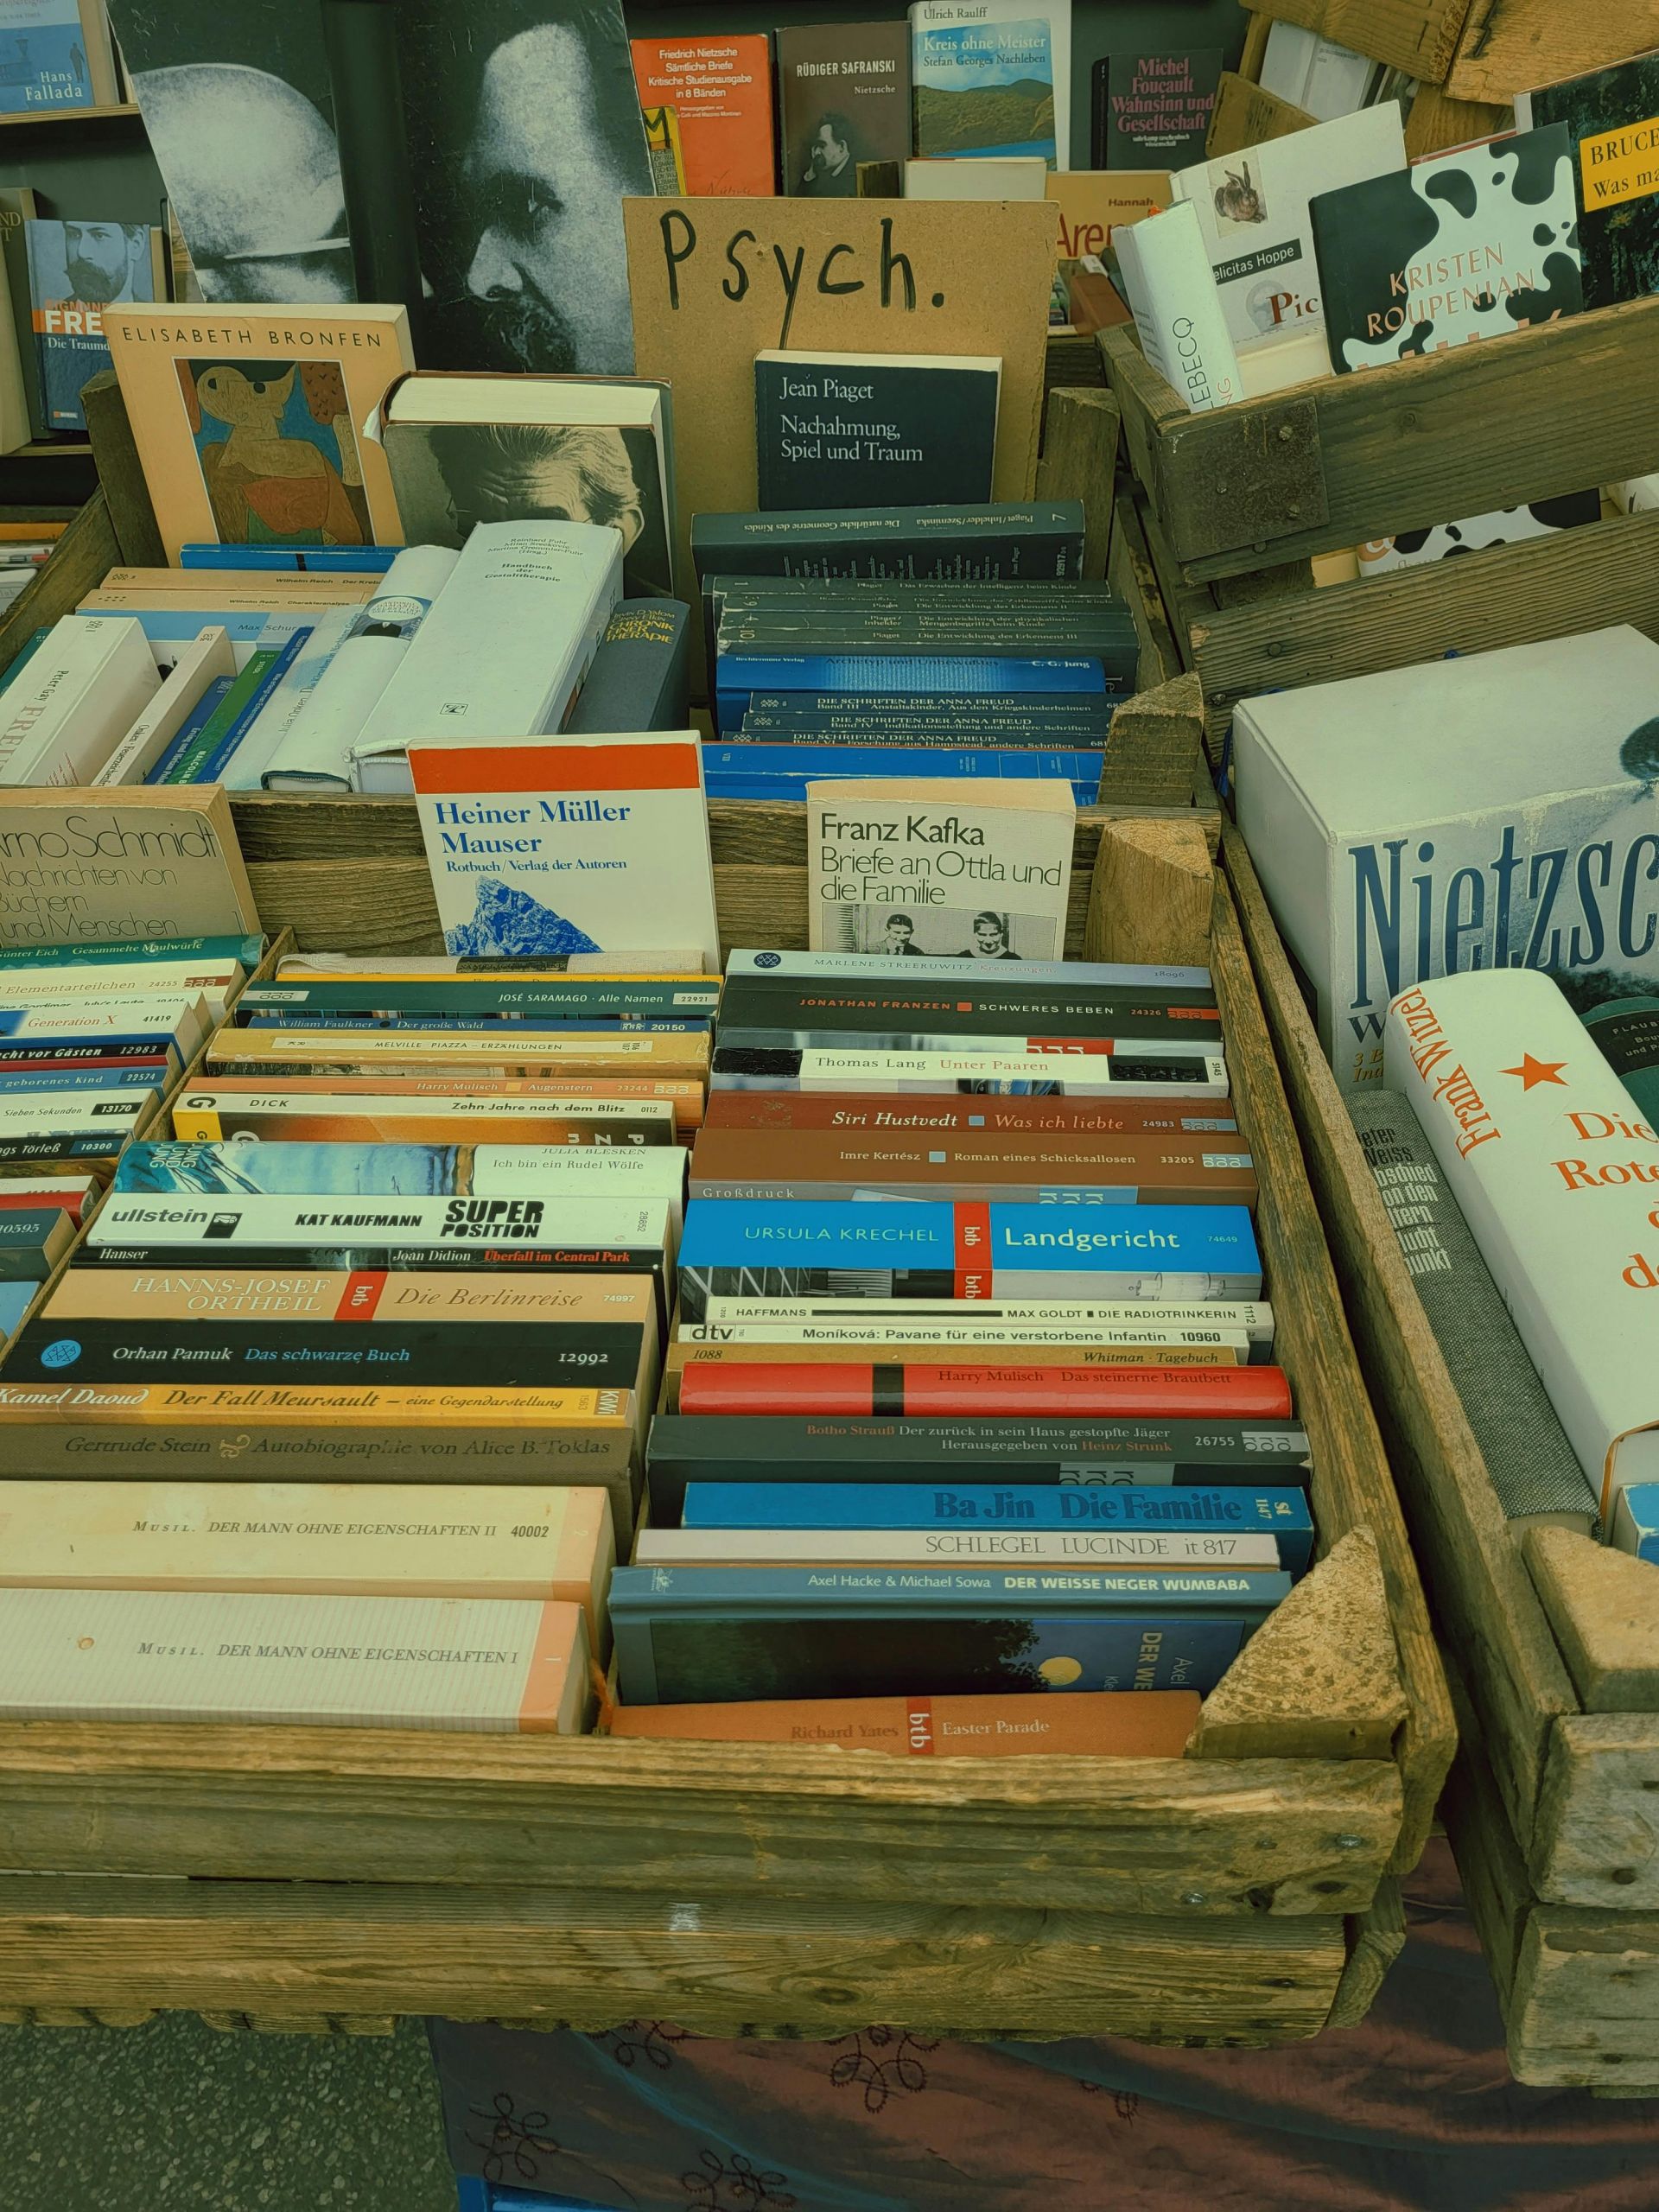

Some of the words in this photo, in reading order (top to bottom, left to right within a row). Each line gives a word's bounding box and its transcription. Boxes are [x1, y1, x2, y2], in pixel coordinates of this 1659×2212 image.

[924, 7, 954, 20] Ulrich
[957, 6, 988, 19] Raulff
[924, 36, 957, 51] Kreis
[961, 37, 993, 51] ohne
[998, 35, 1046, 49] Meister
[659, 49, 695, 59] Friedrich
[697, 48, 737, 58] Nietzsche
[923, 55, 952, 67] Stefan
[956, 55, 993, 68] Georges
[995, 53, 1046, 65] Nachleben
[665, 61, 704, 73] Sämtliche
[706, 60, 733, 71] Briefe
[797, 63, 838, 77] RÜDIGER
[842, 60, 895, 74] SAFRANSKI
[1137, 57, 1190, 77] Michel
[41, 71, 72, 82] Hans
[648, 75, 683, 86] Kritische
[685, 73, 752, 86] Studienausgabe
[1131, 75, 1193, 94] Foucault
[25, 85, 82, 101] Fallada
[693, 86, 726, 98] Bänden
[854, 84, 895, 94] Nietzsche
[1112, 94, 1184, 114] Wahnsinn
[1186, 92, 1214, 111] und
[1117, 112, 1205, 133] Gesellschaft
[1592, 178, 1630, 199] Was
[1256, 246, 1295, 267] Hoppe
[1389, 243, 1505, 296] KRISTEN
[659, 209, 944, 351] Psych.
[1366, 268, 1536, 337] ROUPENIAN
[123, 327, 252, 345] ELISABETH
[269, 330, 382, 347] BRONFEN
[779, 377, 817, 399] Jean
[823, 380, 874, 401] Piaget
[780, 415, 900, 440] Nachahmung,
[780, 441, 821, 461] Spiel
[827, 443, 860, 461] und
[864, 443, 923, 461] Traum
[434, 803, 531, 828] Heiner
[540, 798, 631, 824] Müller
[67, 813, 216, 861] Schmidt
[821, 814, 899, 842] Franz
[906, 816, 985, 846] Kafka
[442, 831, 542, 855] Mauser
[551, 859, 572, 872] der
[575, 857, 627, 870] Autoren
[822, 848, 894, 874] Briefe
[899, 856, 931, 876] an
[936, 851, 1007, 882] Ottla
[1013, 861, 1061, 887] und
[135, 868, 177, 887] von
[821, 879, 859, 901] die
[862, 880, 946, 905] Familie
[0, 915, 47, 940] und
[48, 912, 178, 938] Menschen
[7, 979, 136, 995] Elementarteilchen
[498, 991, 524, 1003] JOSÉ
[527, 994, 588, 1003] SARAMAGO
[598, 994, 619, 1003] Alle
[623, 995, 664, 1004] Namen
[798, 998, 877, 1010] JONATHAN
[882, 1001, 950, 1012] FRANZEN
[979, 1003, 1059, 1014] SCHWERES
[1065, 1005, 1115, 1015] BEBEN
[28, 1016, 100, 1028] Generation
[104, 1014, 118, 1025] X
[1390, 988, 1453, 1084] Witzel
[29, 1049, 51, 1059] vor
[54, 1046, 102, 1058] Gästen
[120, 1045, 157, 1055] 12983
[815, 1058, 879, 1069] Thomas
[886, 1058, 926, 1071] Lang
[939, 1059, 986, 1070] Unter
[992, 1060, 1048, 1071] Paaren
[101, 1103, 132, 1114] 13170
[249, 1098, 289, 1108] DICK
[488, 1103, 524, 1112] Jahre
[1433, 1064, 1502, 1160] Frank
[111, 1207, 208, 1224] ullstein
[295, 1212, 327, 1225] KAT
[329, 1213, 423, 1227] KAUFMANN
[445, 1199, 544, 1224] SUPER
[440, 1222, 540, 1238] POSITION
[745, 1228, 831, 1240] URSULA
[840, 1229, 938, 1242] KRECHEL
[963, 1225, 982, 1246] btb
[1005, 1227, 1180, 1251] Landgericht
[131, 1278, 331, 1294] HANNS-JOSEF
[350, 1285, 372, 1306] btb
[187, 1295, 323, 1312] ORTHEIL
[394, 1287, 442, 1306] Die
[448, 1287, 583, 1309] Berlinreise
[603, 1294, 635, 1304] 74997
[1007, 1309, 1035, 1319] MAX
[1039, 1309, 1082, 1319] GOLDT
[1098, 1309, 1121, 1319] DIE
[1124, 1309, 1236, 1320] RADIOTRINKERIN
[691, 1324, 734, 1340] dtv
[802, 1327, 880, 1340] Moníková:
[885, 1329, 942, 1341] Pavane
[946, 1329, 969, 1342] für
[973, 1330, 1007, 1342] eine
[1011, 1330, 1104, 1342] verstorbene
[1109, 1331, 1166, 1343] Infantin
[1179, 1331, 1221, 1343] 10960
[112, 1345, 170, 1362] Orhan
[174, 1345, 233, 1363] Pamuk
[244, 1347, 280, 1362] Das
[282, 1347, 362, 1363] schwarze
[366, 1347, 410, 1363] Buch
[558, 1352, 608, 1364] 12992
[926, 1535, 1046, 1555] SCHLEGEL
[1063, 1537, 1169, 1555] LUCINDE
[1185, 1538, 1197, 1555] it
[1201, 1538, 1236, 1557] 817
[807, 1574, 836, 1587] Axel
[840, 1574, 882, 1588] Hacke
[886, 1575, 897, 1588] &
[900, 1575, 951, 1589] Michael
[955, 1576, 991, 1589] Sowa
[1005, 1578, 1037, 1589] DER
[1040, 1579, 1102, 1591] WEISSE
[1105, 1579, 1159, 1591] NEGER
[1162, 1579, 1250, 1592] WUMBABA
